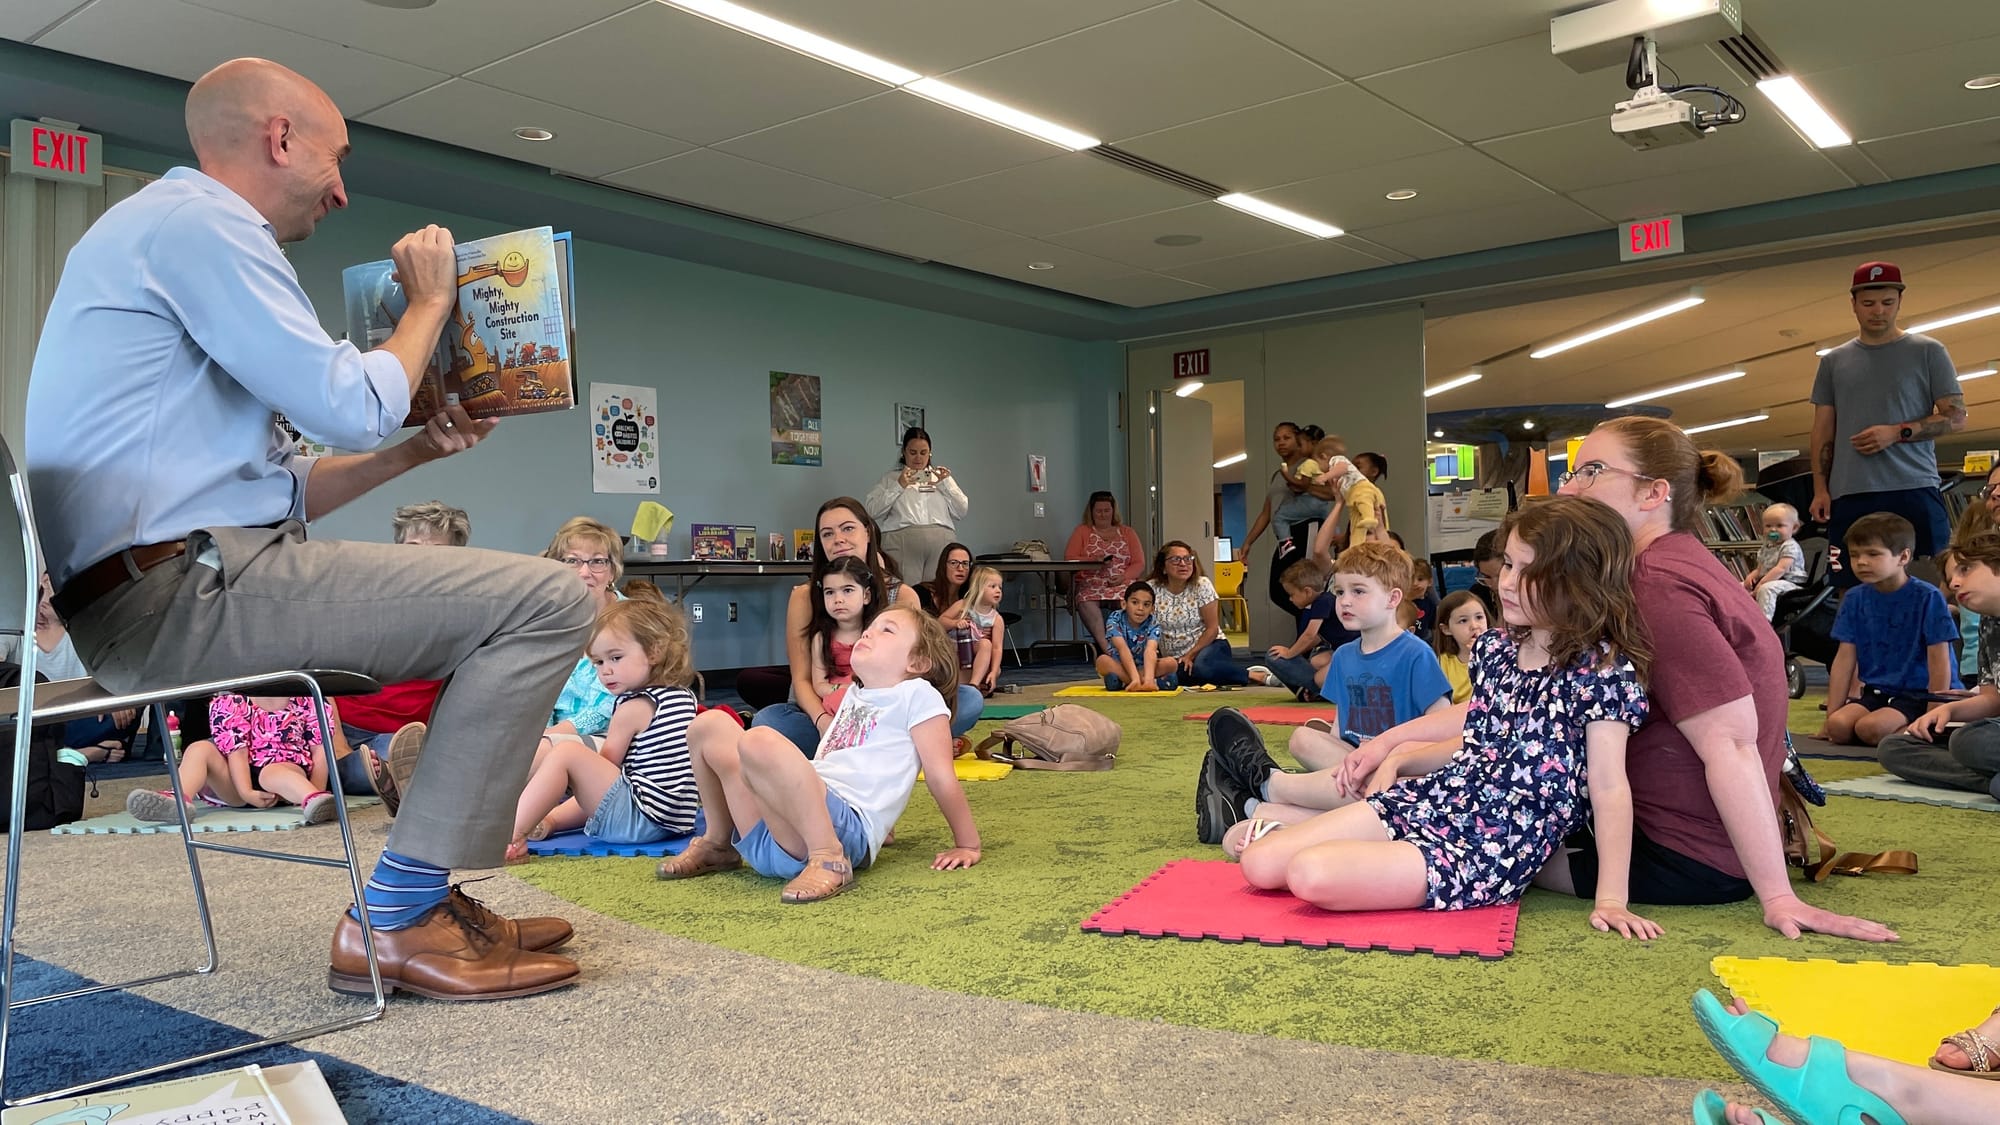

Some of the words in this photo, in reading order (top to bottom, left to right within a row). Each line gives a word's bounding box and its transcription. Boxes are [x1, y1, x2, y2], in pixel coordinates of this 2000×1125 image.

[32, 127, 89, 175] EXIT
[1630, 218, 1672, 253] EXIT
[1870, 266, 1883, 280] P
[472, 286, 504, 301] Mighty,
[489, 300, 520, 315] Mighty
[485, 311, 540, 329] Construction
[500, 328, 517, 340] Site
[1179, 351, 1206, 376] EXIT
[807, 419, 818, 431] ALL
[803, 445, 820, 456] NOW
